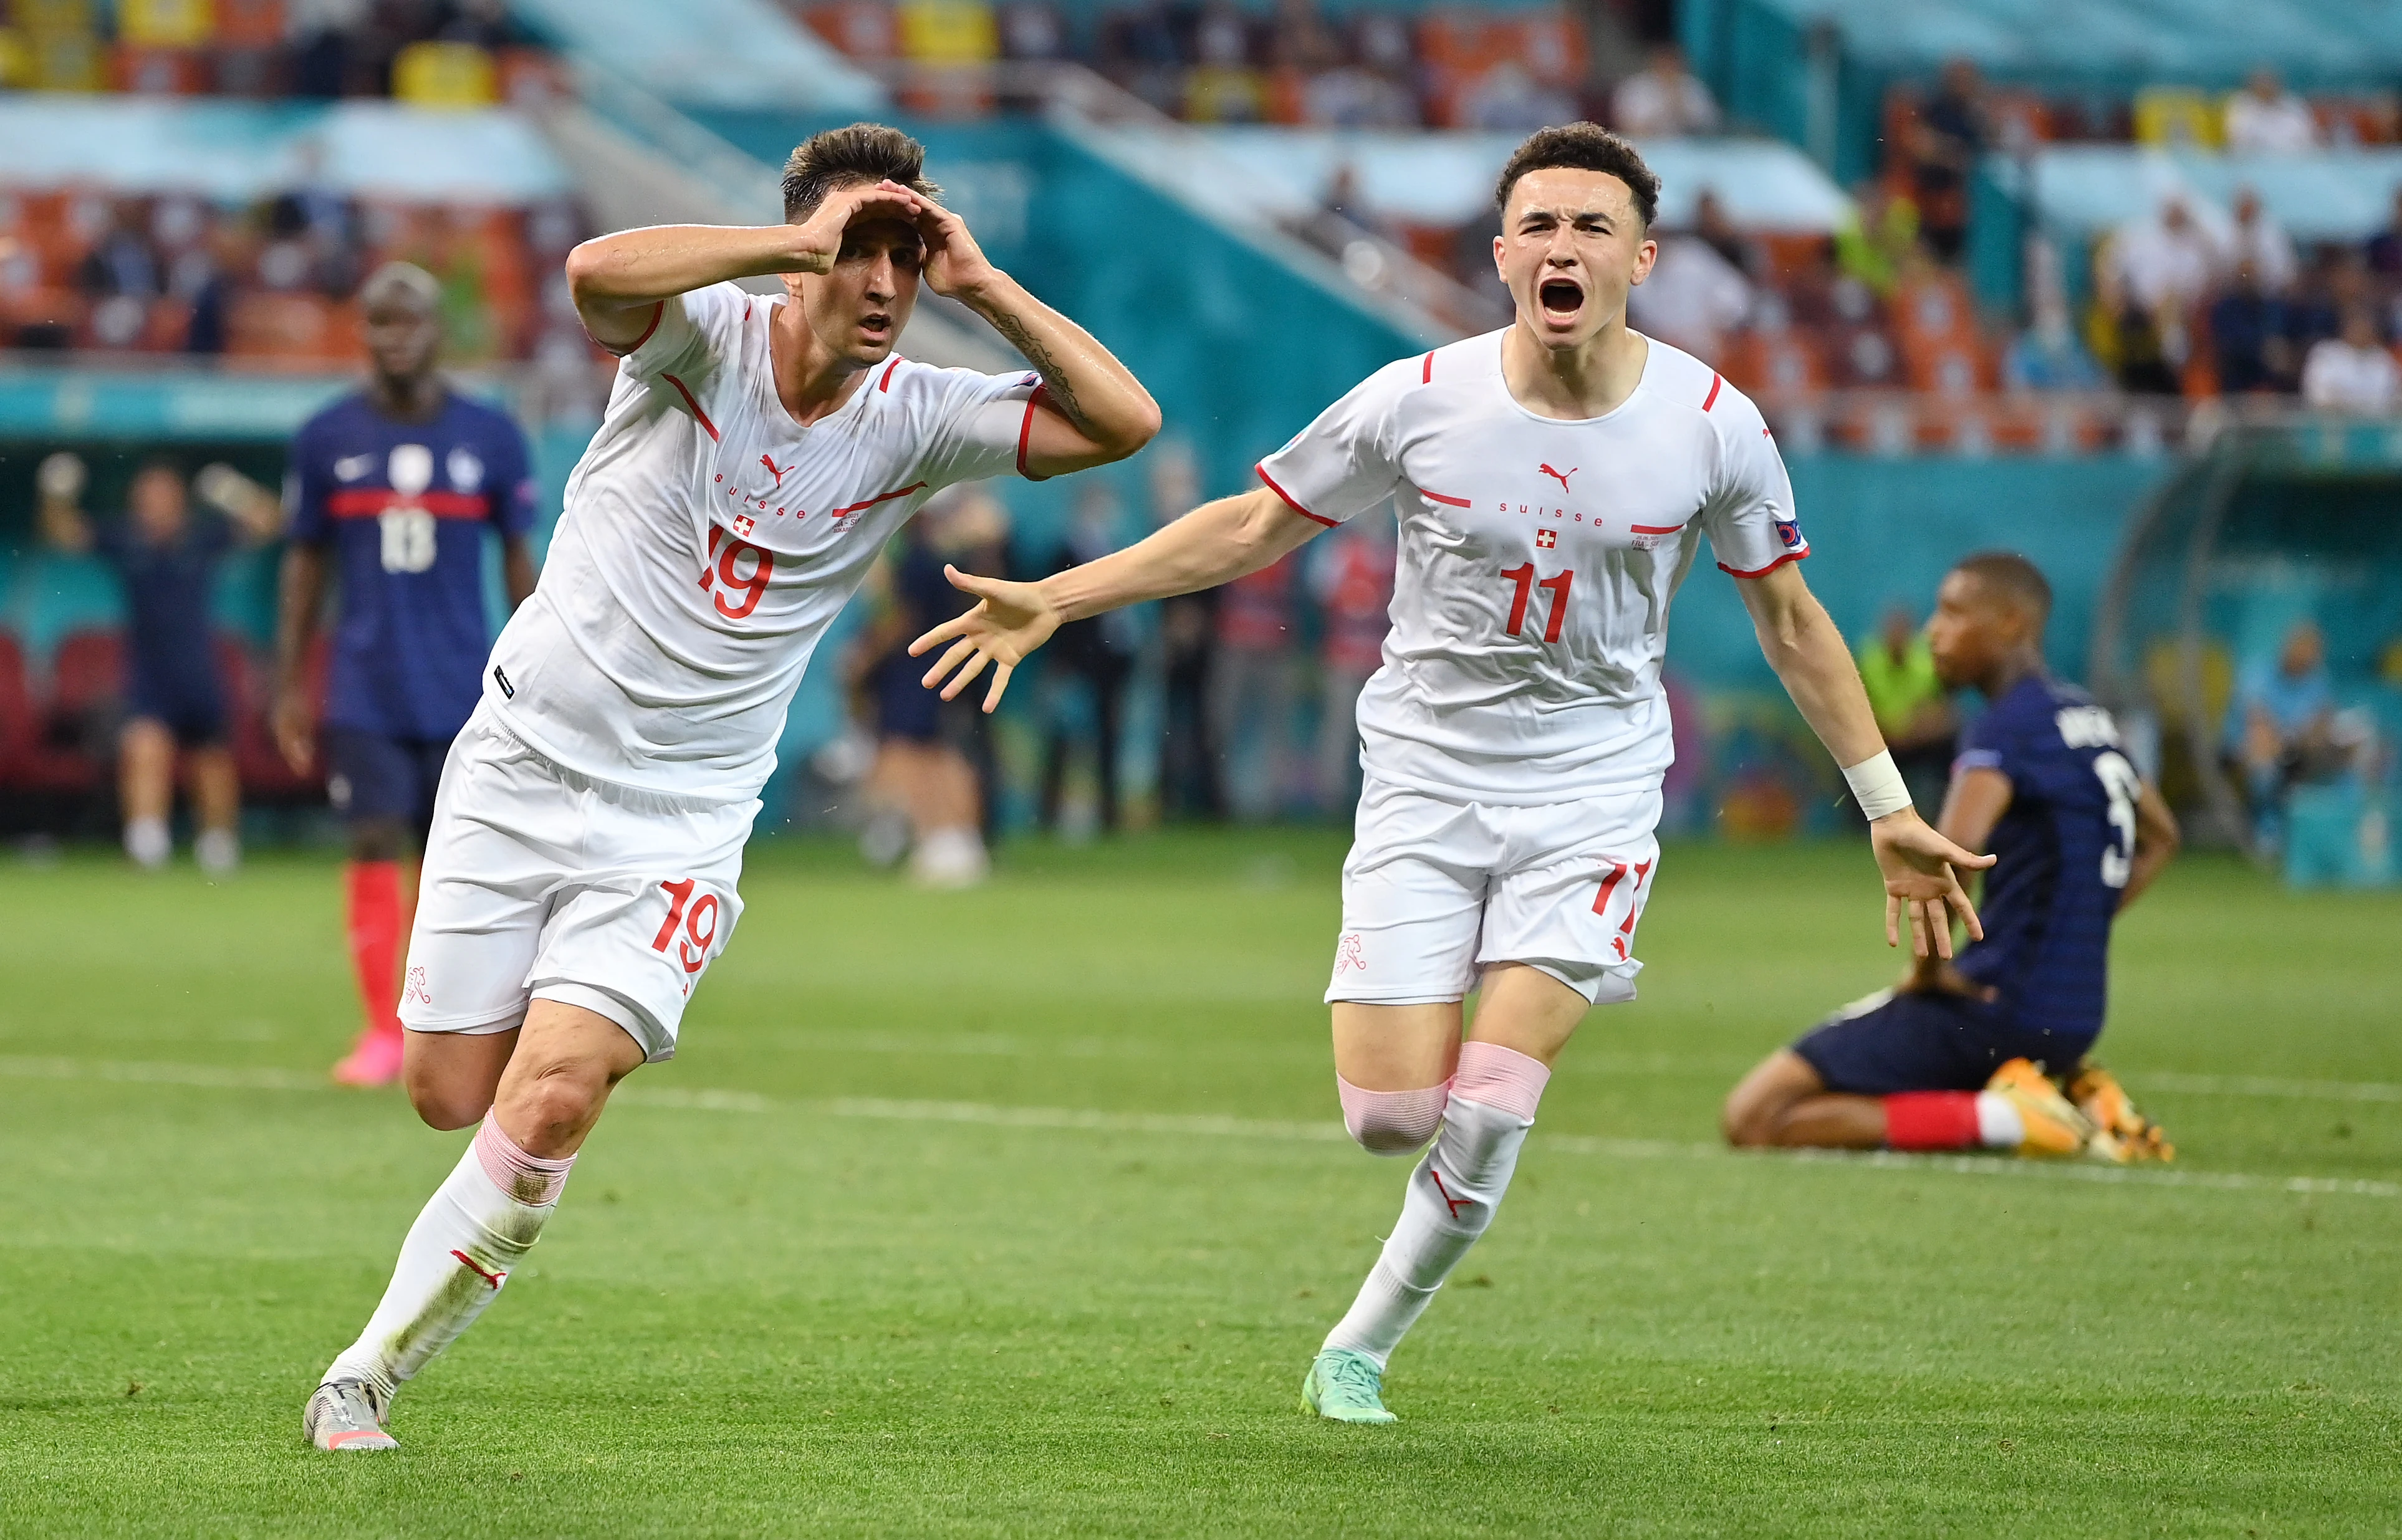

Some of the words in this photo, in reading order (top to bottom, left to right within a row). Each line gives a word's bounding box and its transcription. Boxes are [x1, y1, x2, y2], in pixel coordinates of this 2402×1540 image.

[714, 472, 806, 520] suisse
[1499, 501, 1603, 527] suisse
[697, 524, 774, 619] 19
[1501, 562, 1574, 644] 11
[651, 878, 718, 973] 19
